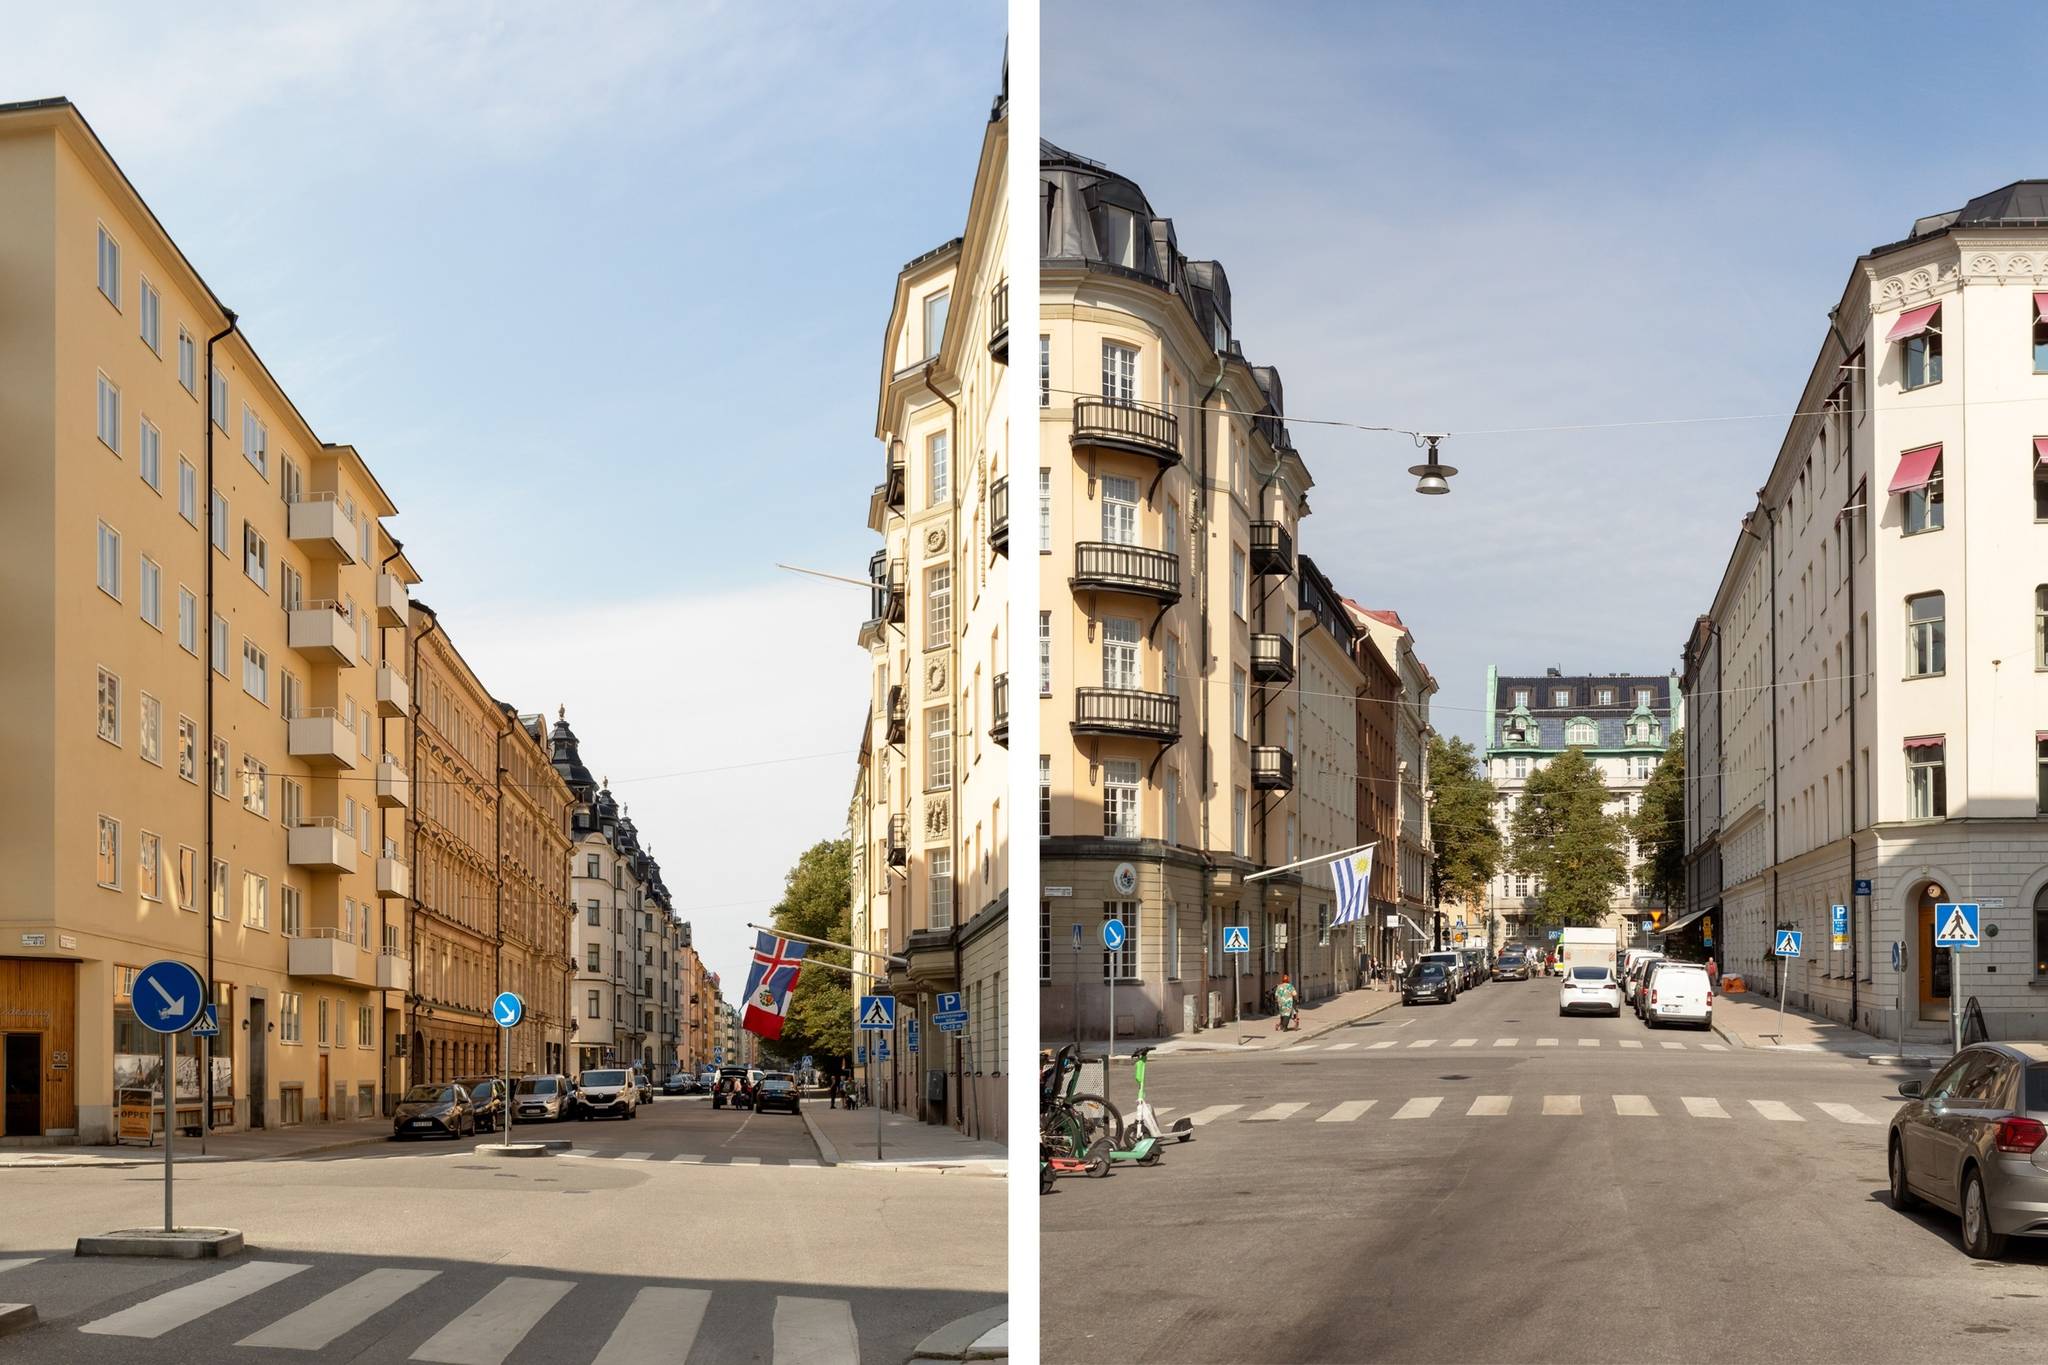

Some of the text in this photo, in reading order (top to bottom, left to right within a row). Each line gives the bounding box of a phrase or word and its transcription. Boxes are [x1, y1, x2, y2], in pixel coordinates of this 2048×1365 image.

[1836, 907, 1846, 919] P
[944, 995, 956, 1011] P
[53, 1050, 69, 1062] 53
